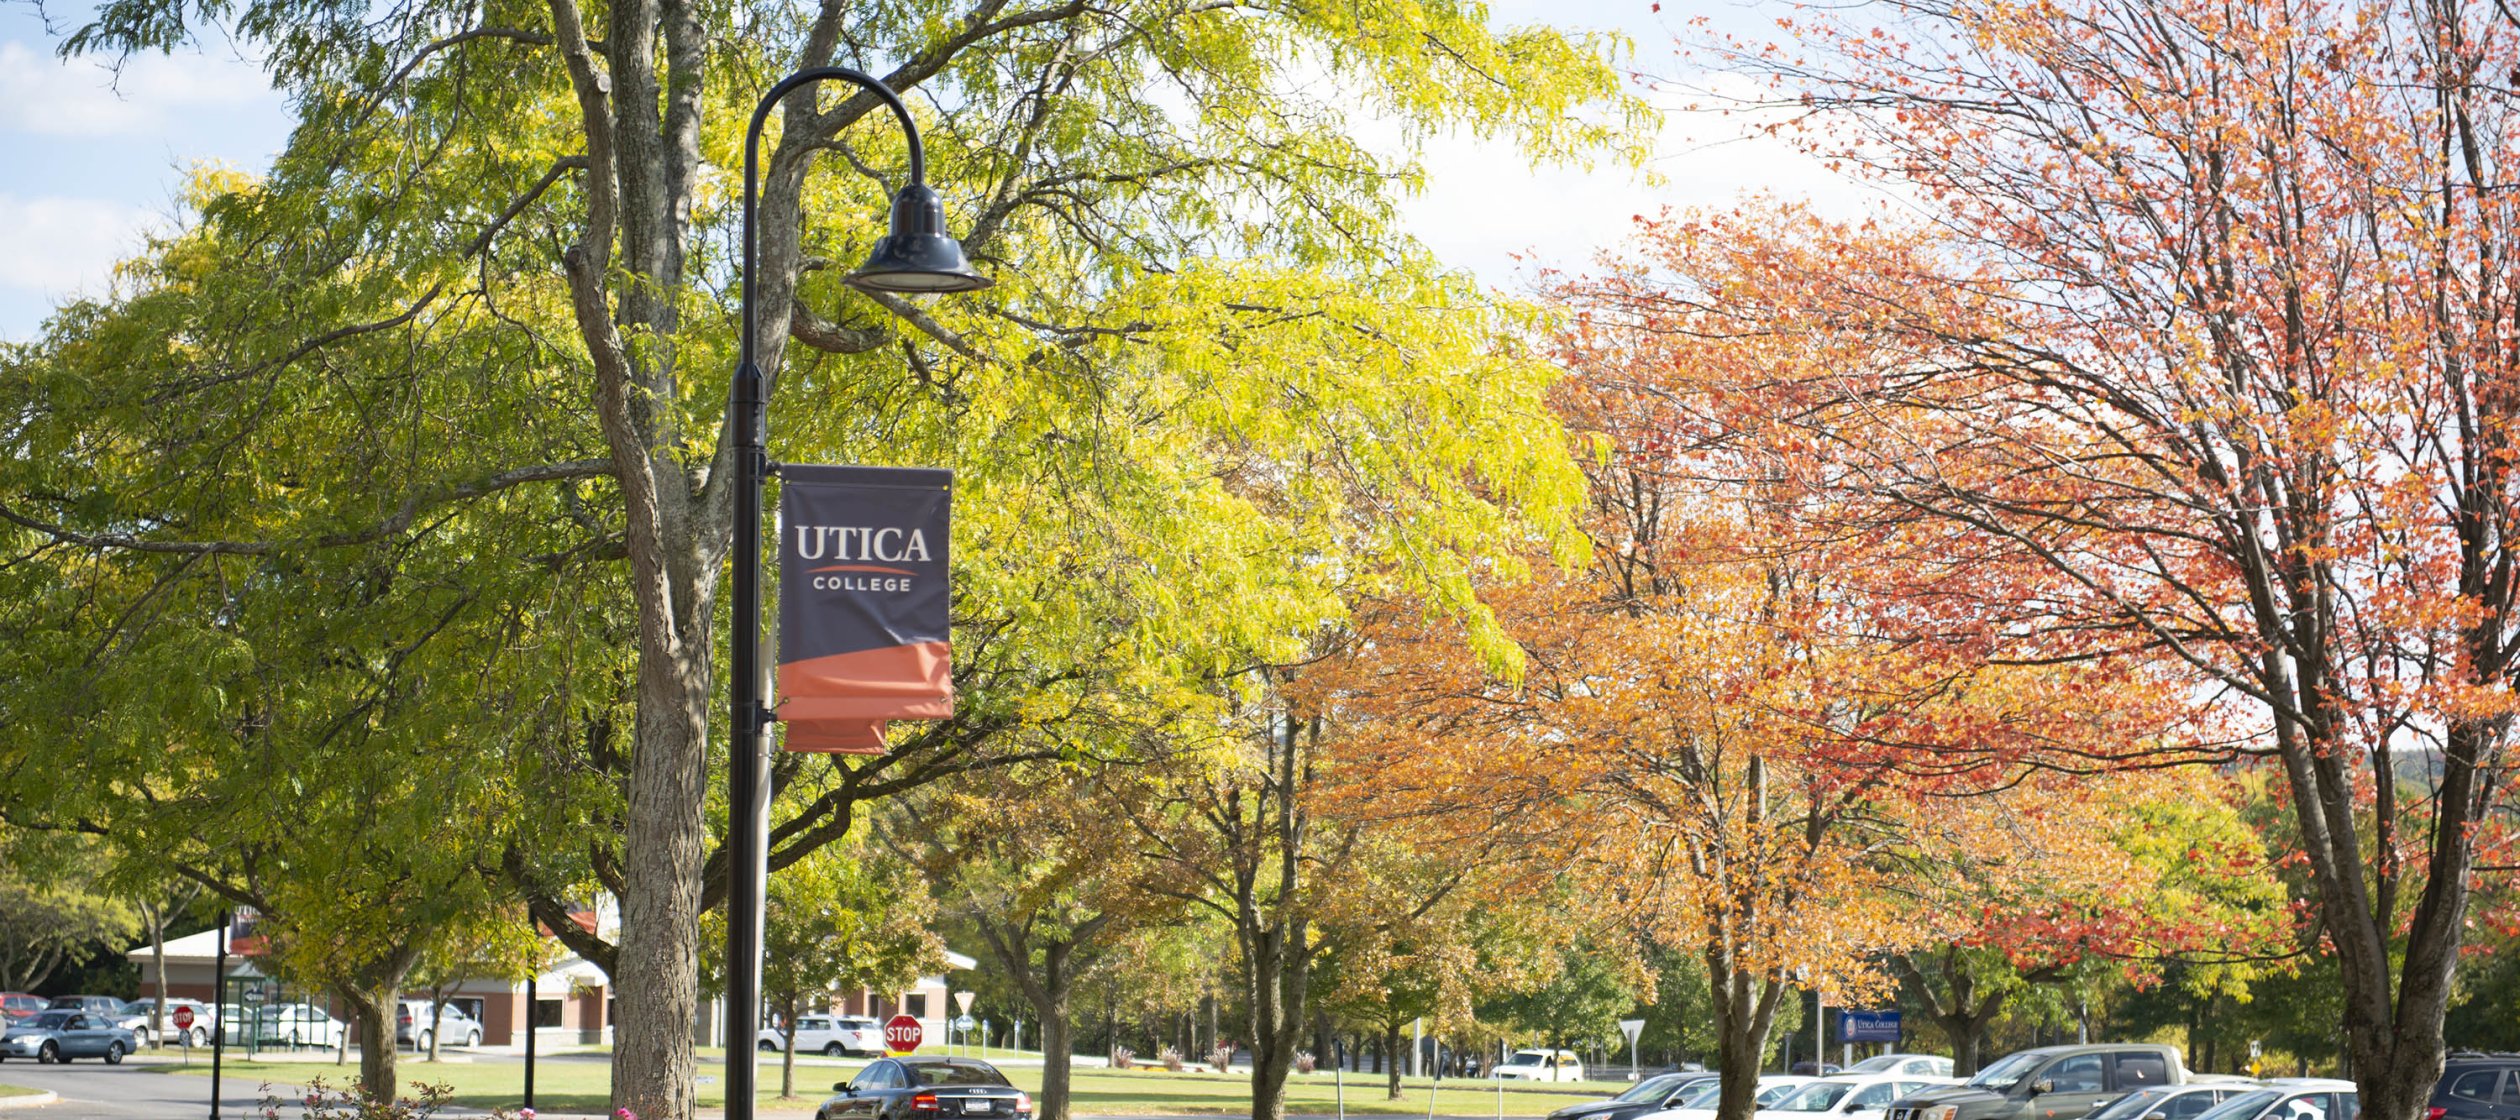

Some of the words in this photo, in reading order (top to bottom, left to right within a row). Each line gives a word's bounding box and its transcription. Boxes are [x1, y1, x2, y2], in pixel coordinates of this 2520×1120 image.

[794, 525, 932, 562] UTICA
[813, 576, 911, 592] COLLEGE
[173, 1011, 193, 1024] STOP
[886, 1026, 921, 1042] STOP
